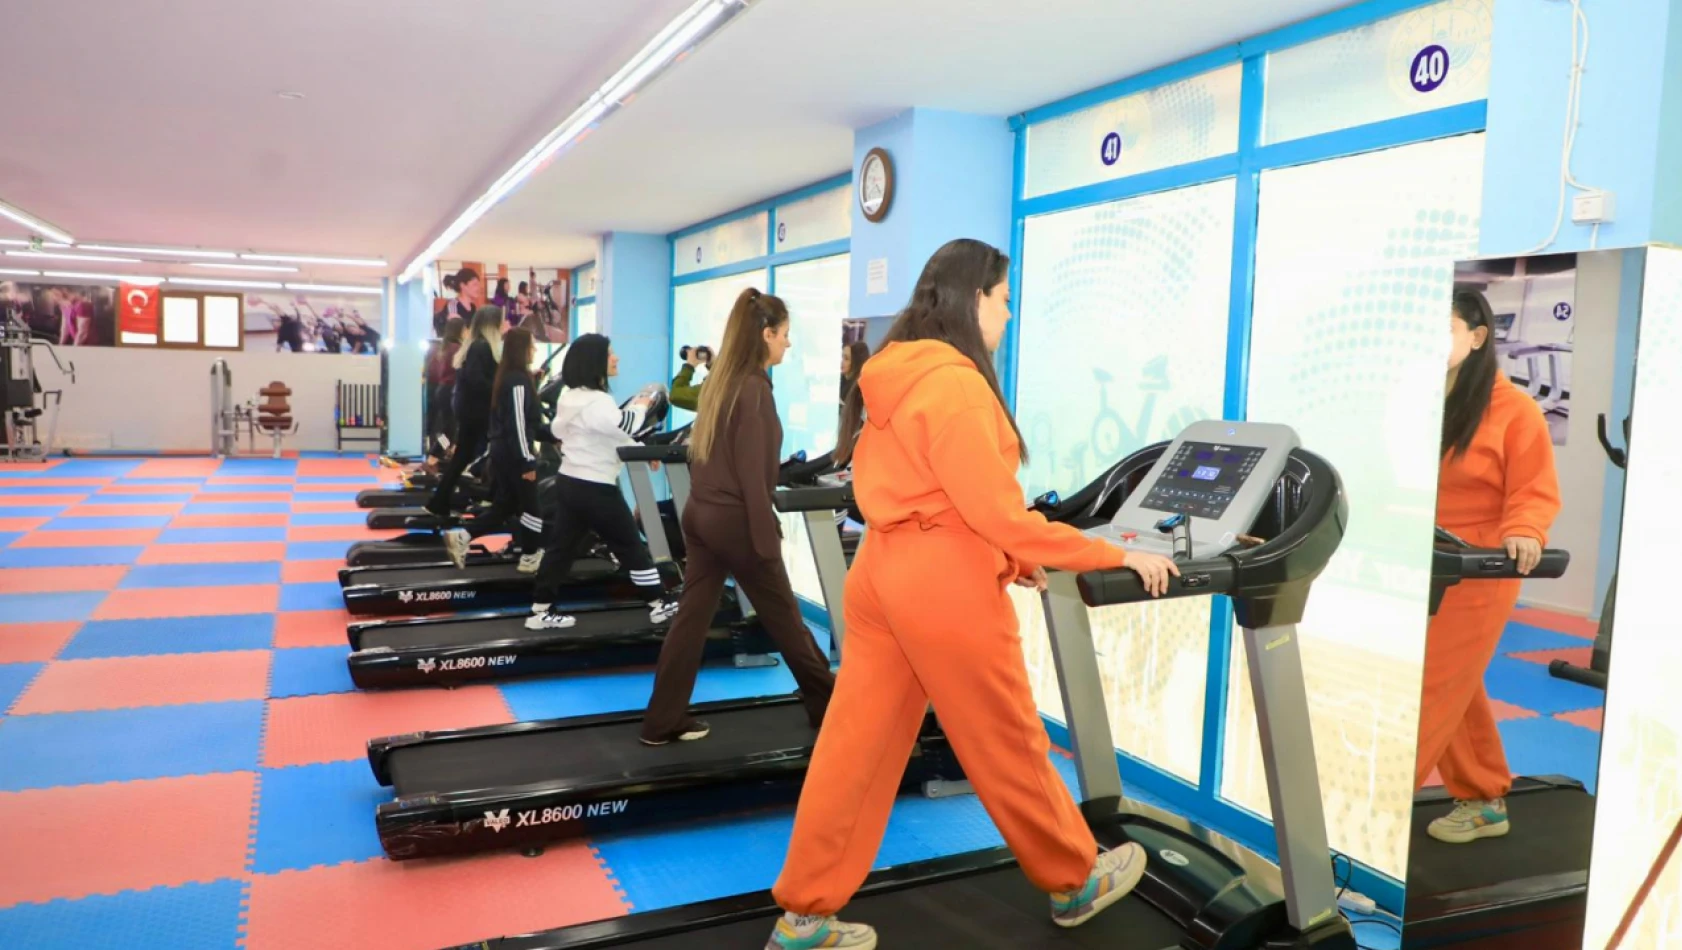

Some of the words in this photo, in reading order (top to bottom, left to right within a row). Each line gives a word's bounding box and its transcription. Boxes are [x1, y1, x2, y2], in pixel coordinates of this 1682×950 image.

[1414, 50, 1445, 86] 40
[1104, 136, 1118, 161] 41
[415, 591, 452, 602] XL8600
[453, 590, 477, 599] NEW
[439, 656, 486, 671] XL8600
[487, 655, 517, 666] NEW
[515, 804, 583, 828] XL8600
[586, 799, 629, 818] NEW
